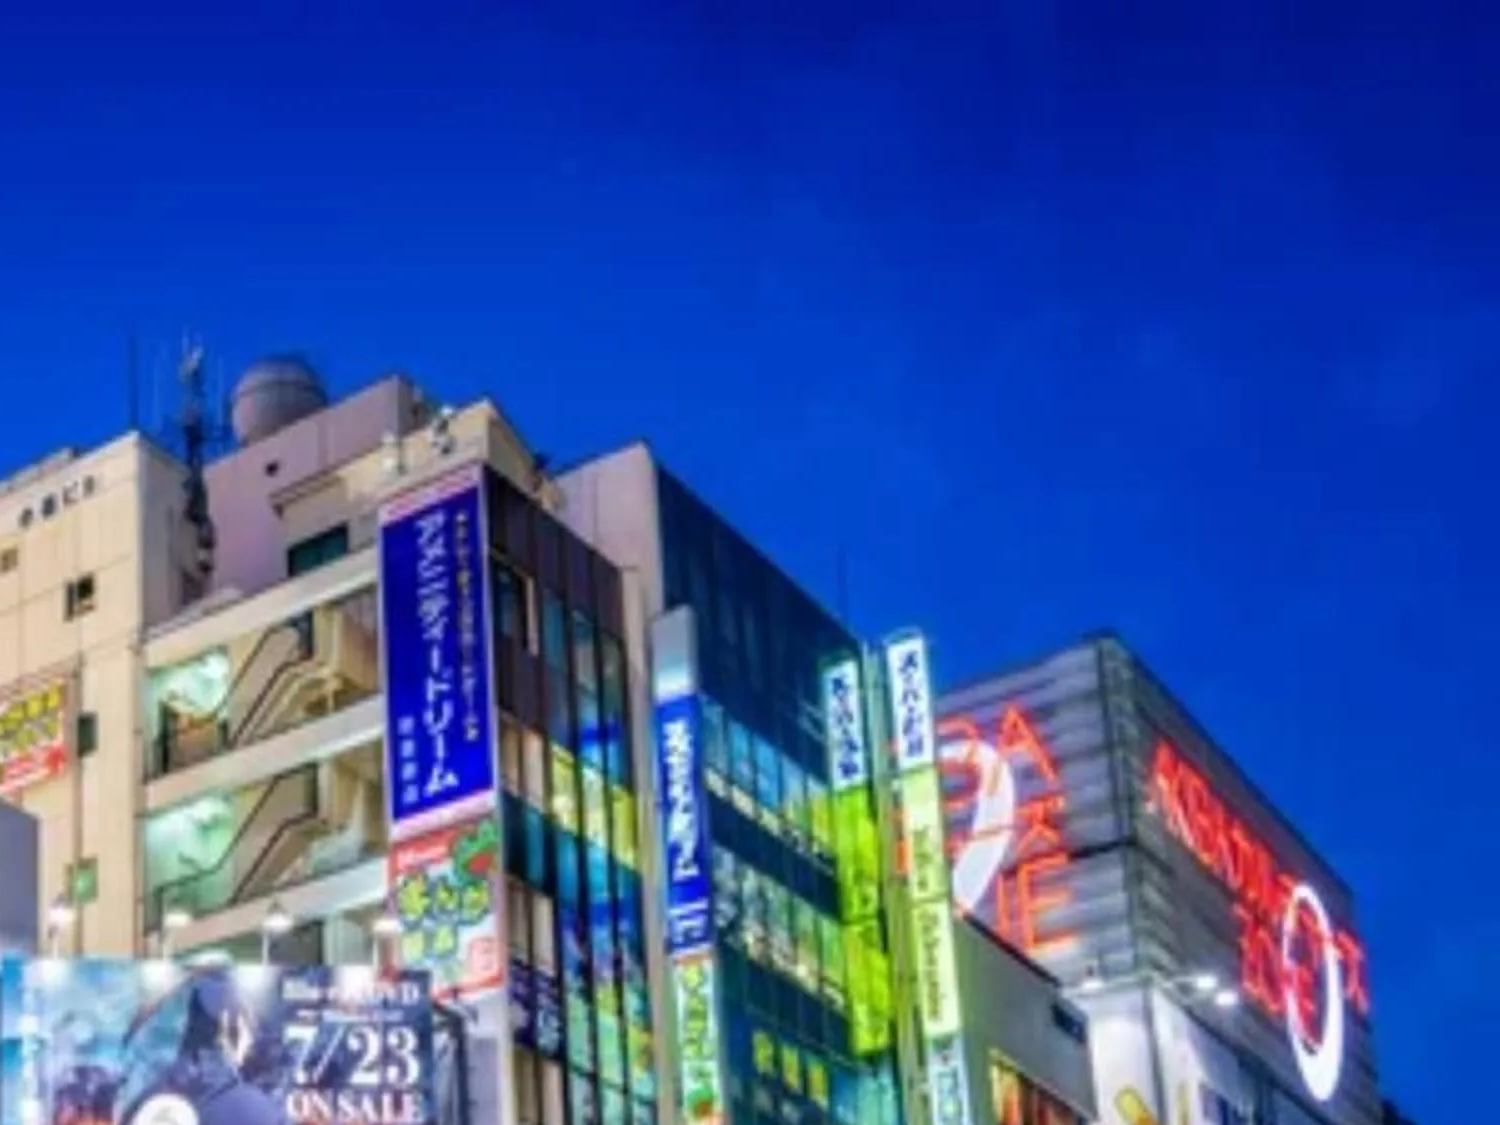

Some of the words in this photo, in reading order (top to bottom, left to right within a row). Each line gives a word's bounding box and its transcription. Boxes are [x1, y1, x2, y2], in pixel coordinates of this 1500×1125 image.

[282, 1025, 421, 1086] 7/23
[285, 1092, 333, 1122] ON
[337, 1094, 424, 1125] SALE
